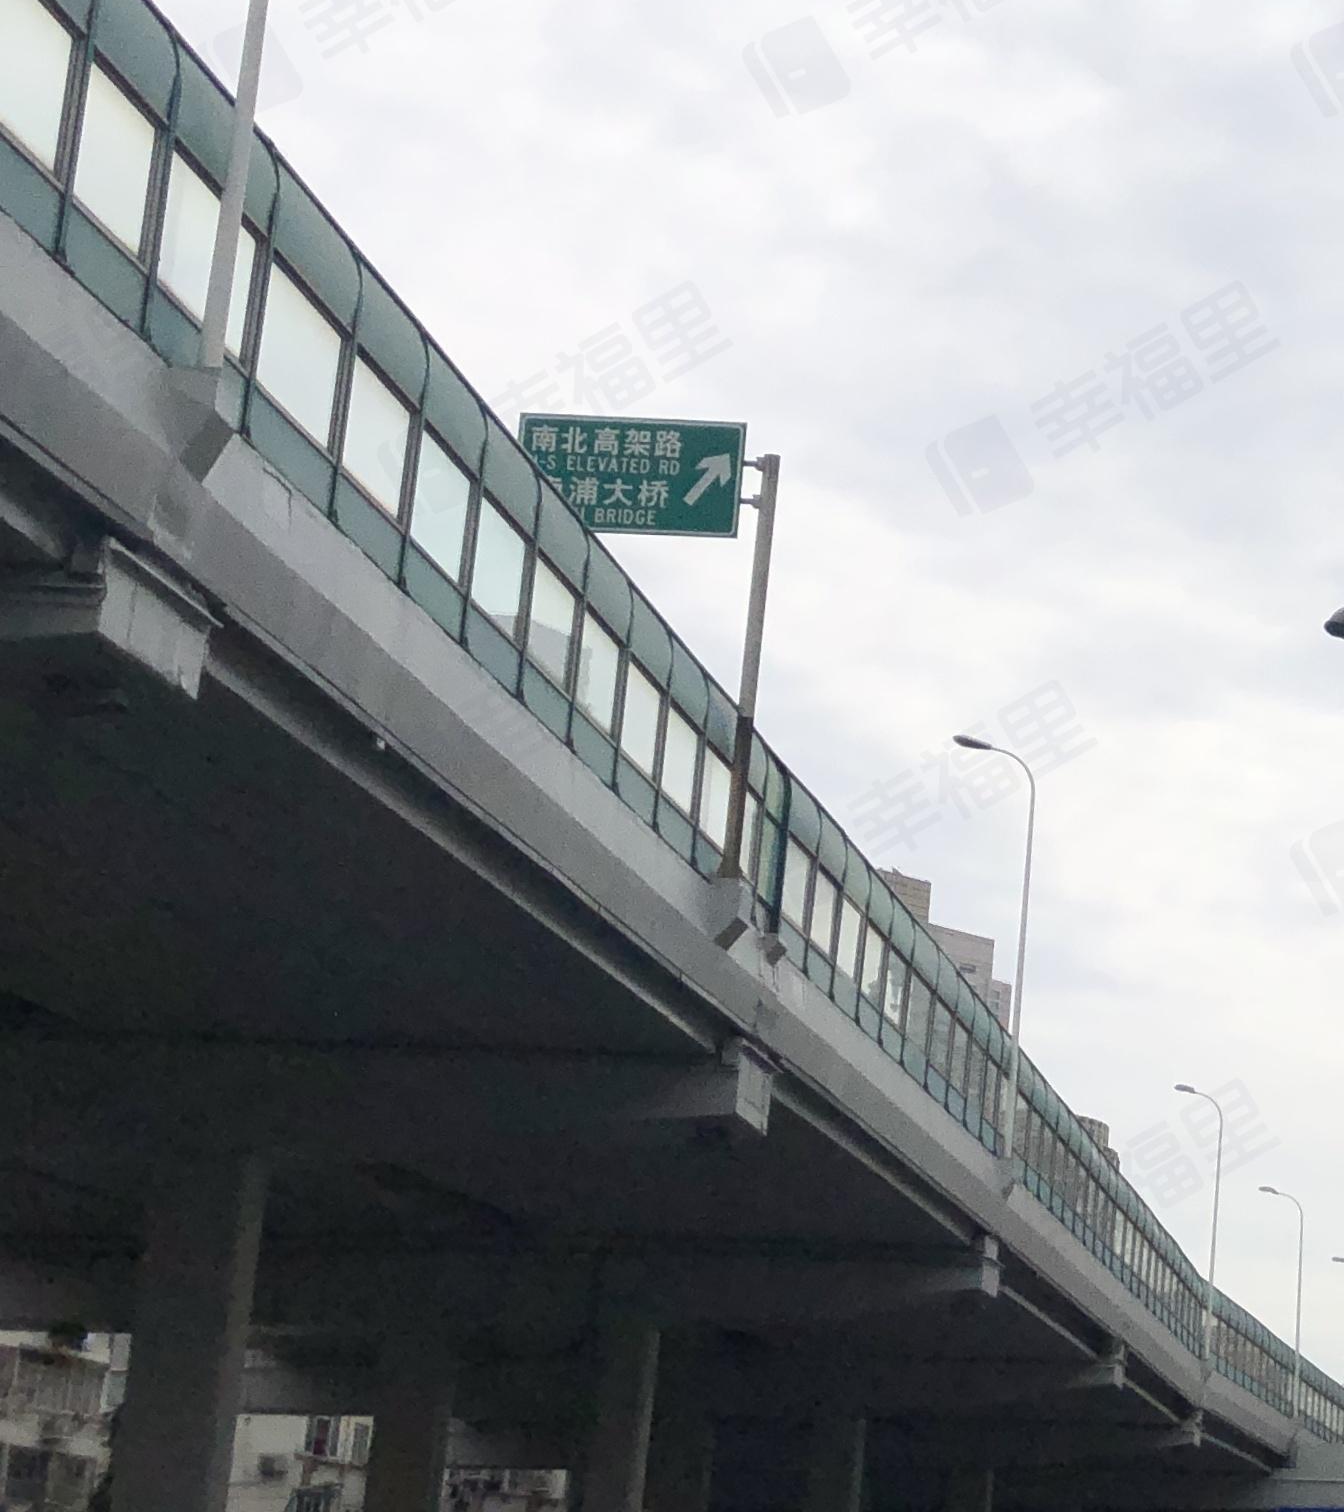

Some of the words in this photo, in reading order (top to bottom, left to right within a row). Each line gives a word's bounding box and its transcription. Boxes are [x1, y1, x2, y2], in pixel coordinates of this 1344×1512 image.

[531, 425, 682, 458] 南北高架路
[567, 455, 650, 474] ELEVATED
[659, 460, 680, 476] RD
[594, 508, 657, 525] BRIDGE
